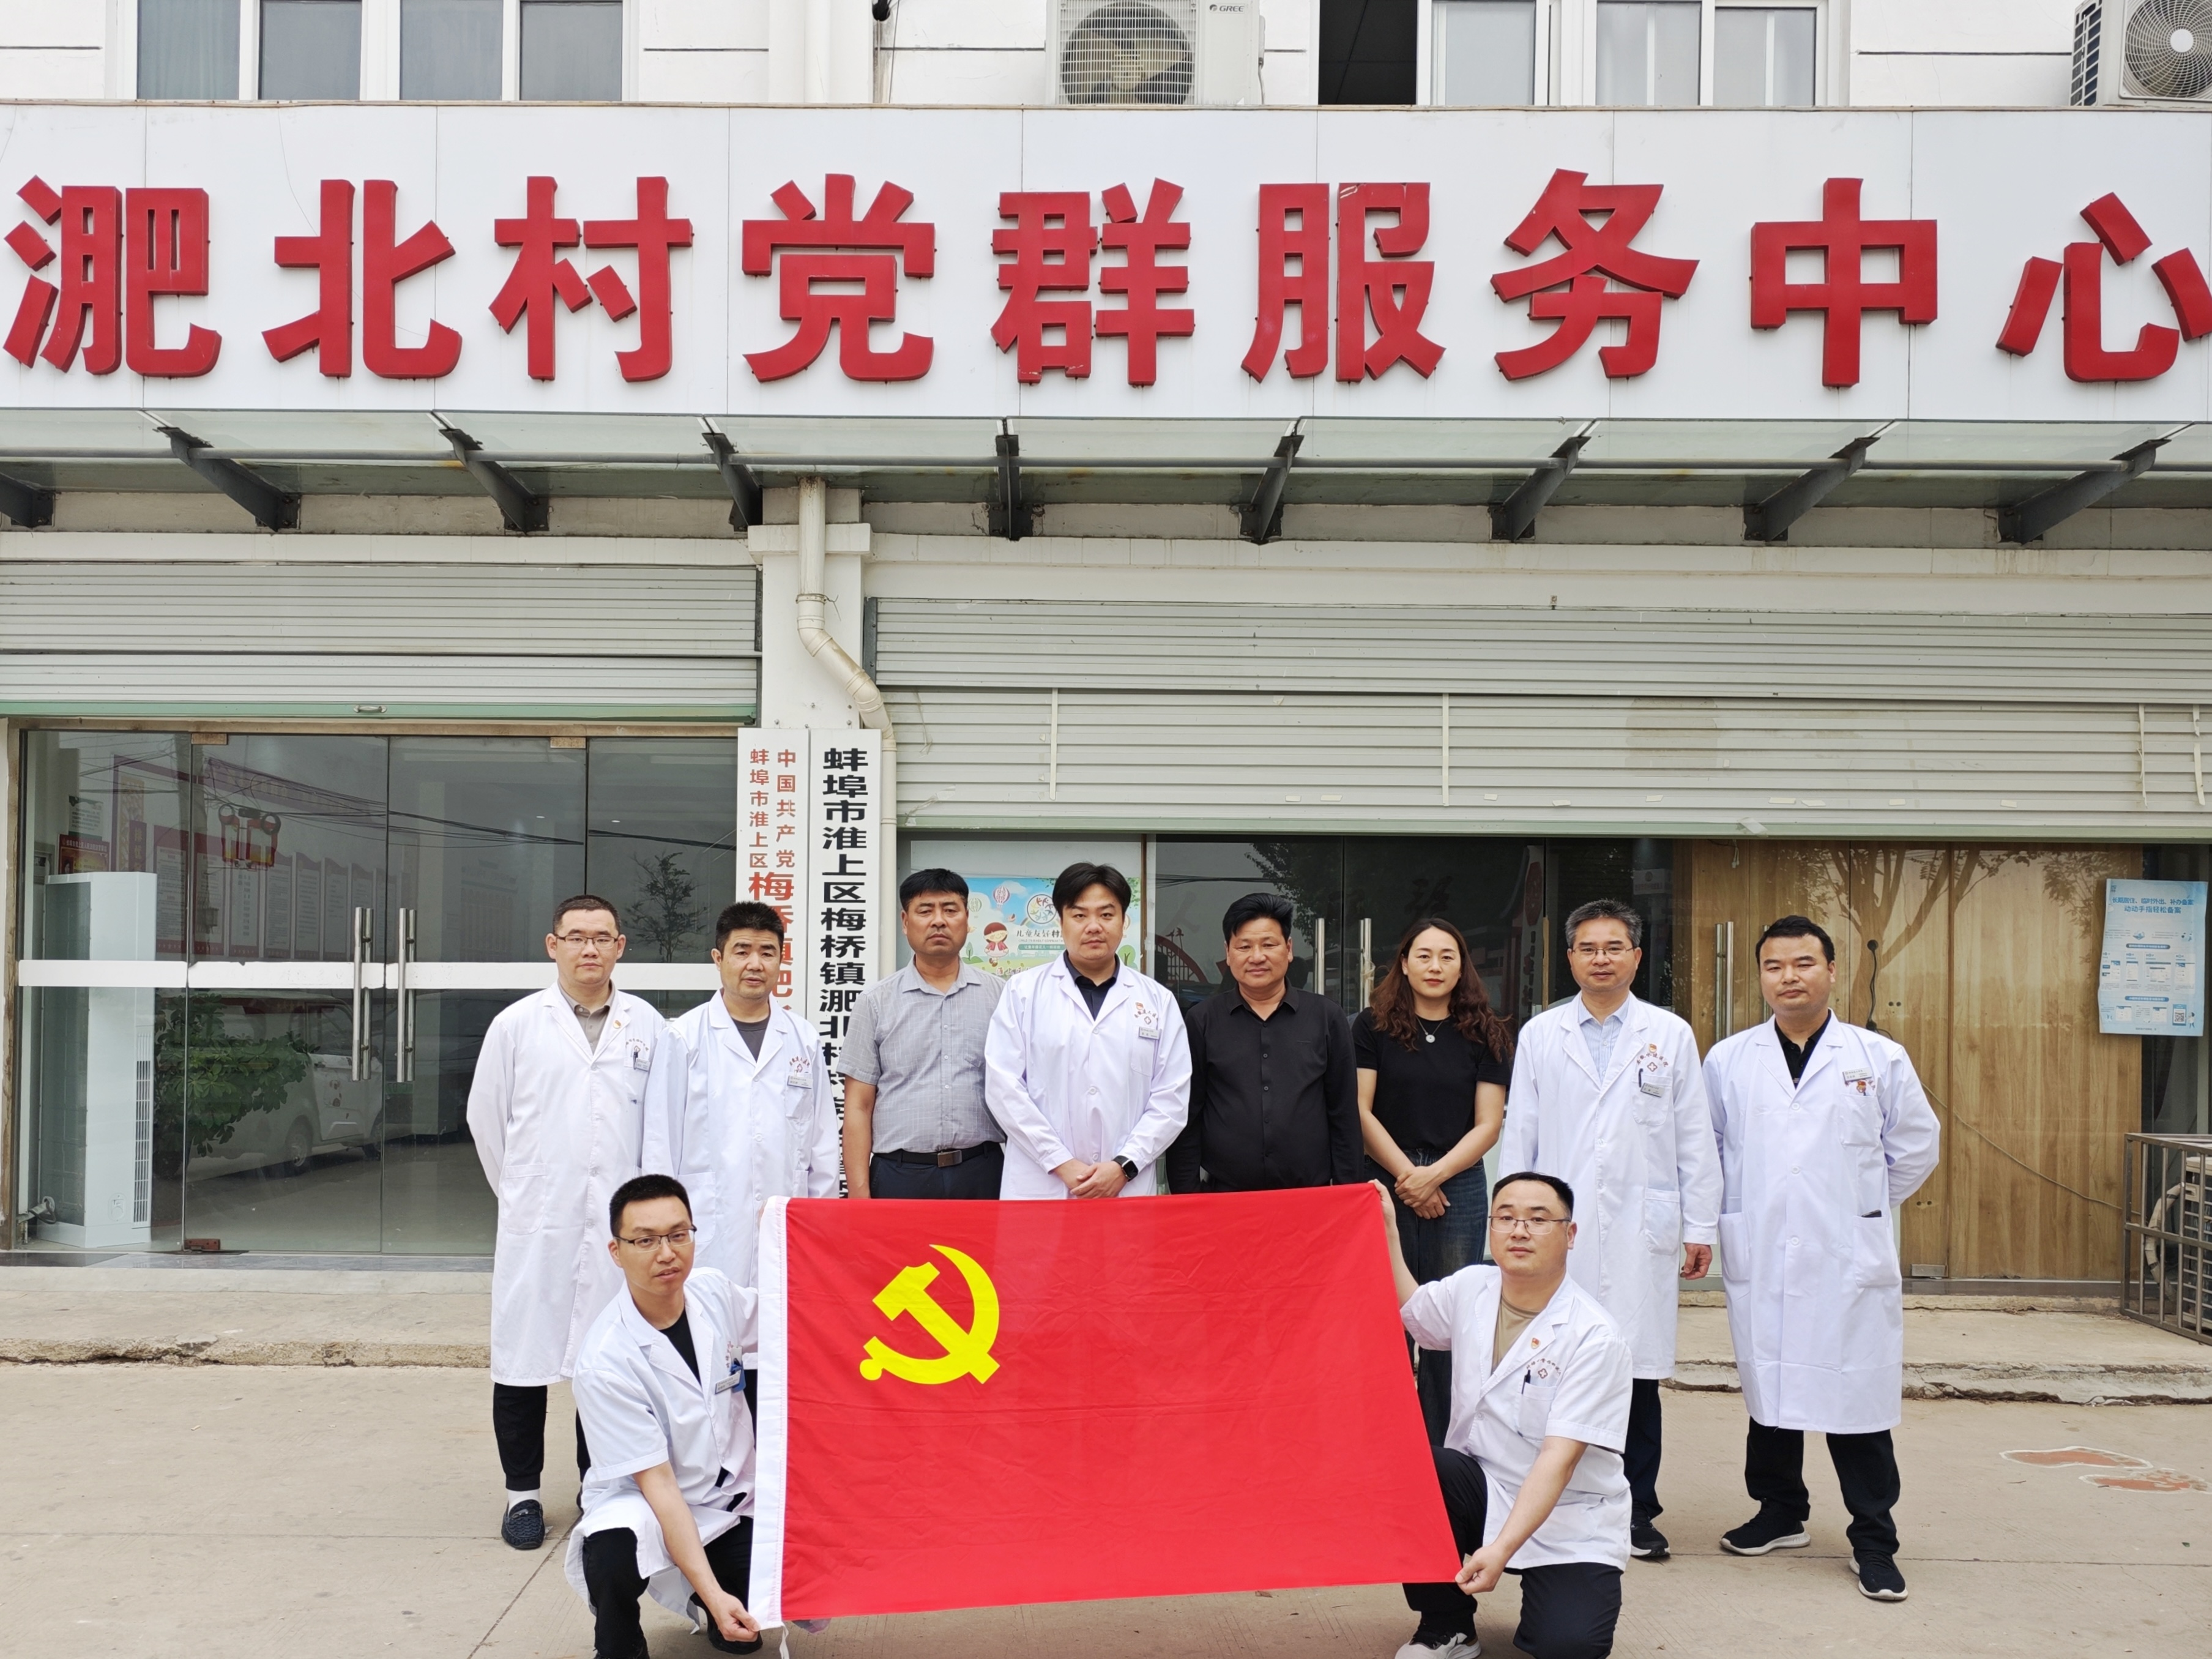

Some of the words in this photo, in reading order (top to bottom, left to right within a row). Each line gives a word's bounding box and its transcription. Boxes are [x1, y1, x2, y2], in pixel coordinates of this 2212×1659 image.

[2, 169, 2212, 386] 淝北村党群服务中心
[749, 749, 770, 868] 蚌埠市淮上区
[776, 749, 796, 868] 中国共产党
[1016, 929, 1063, 938] 儿童友好村
[2124, 905, 2181, 914] 动动手指轻松备案
